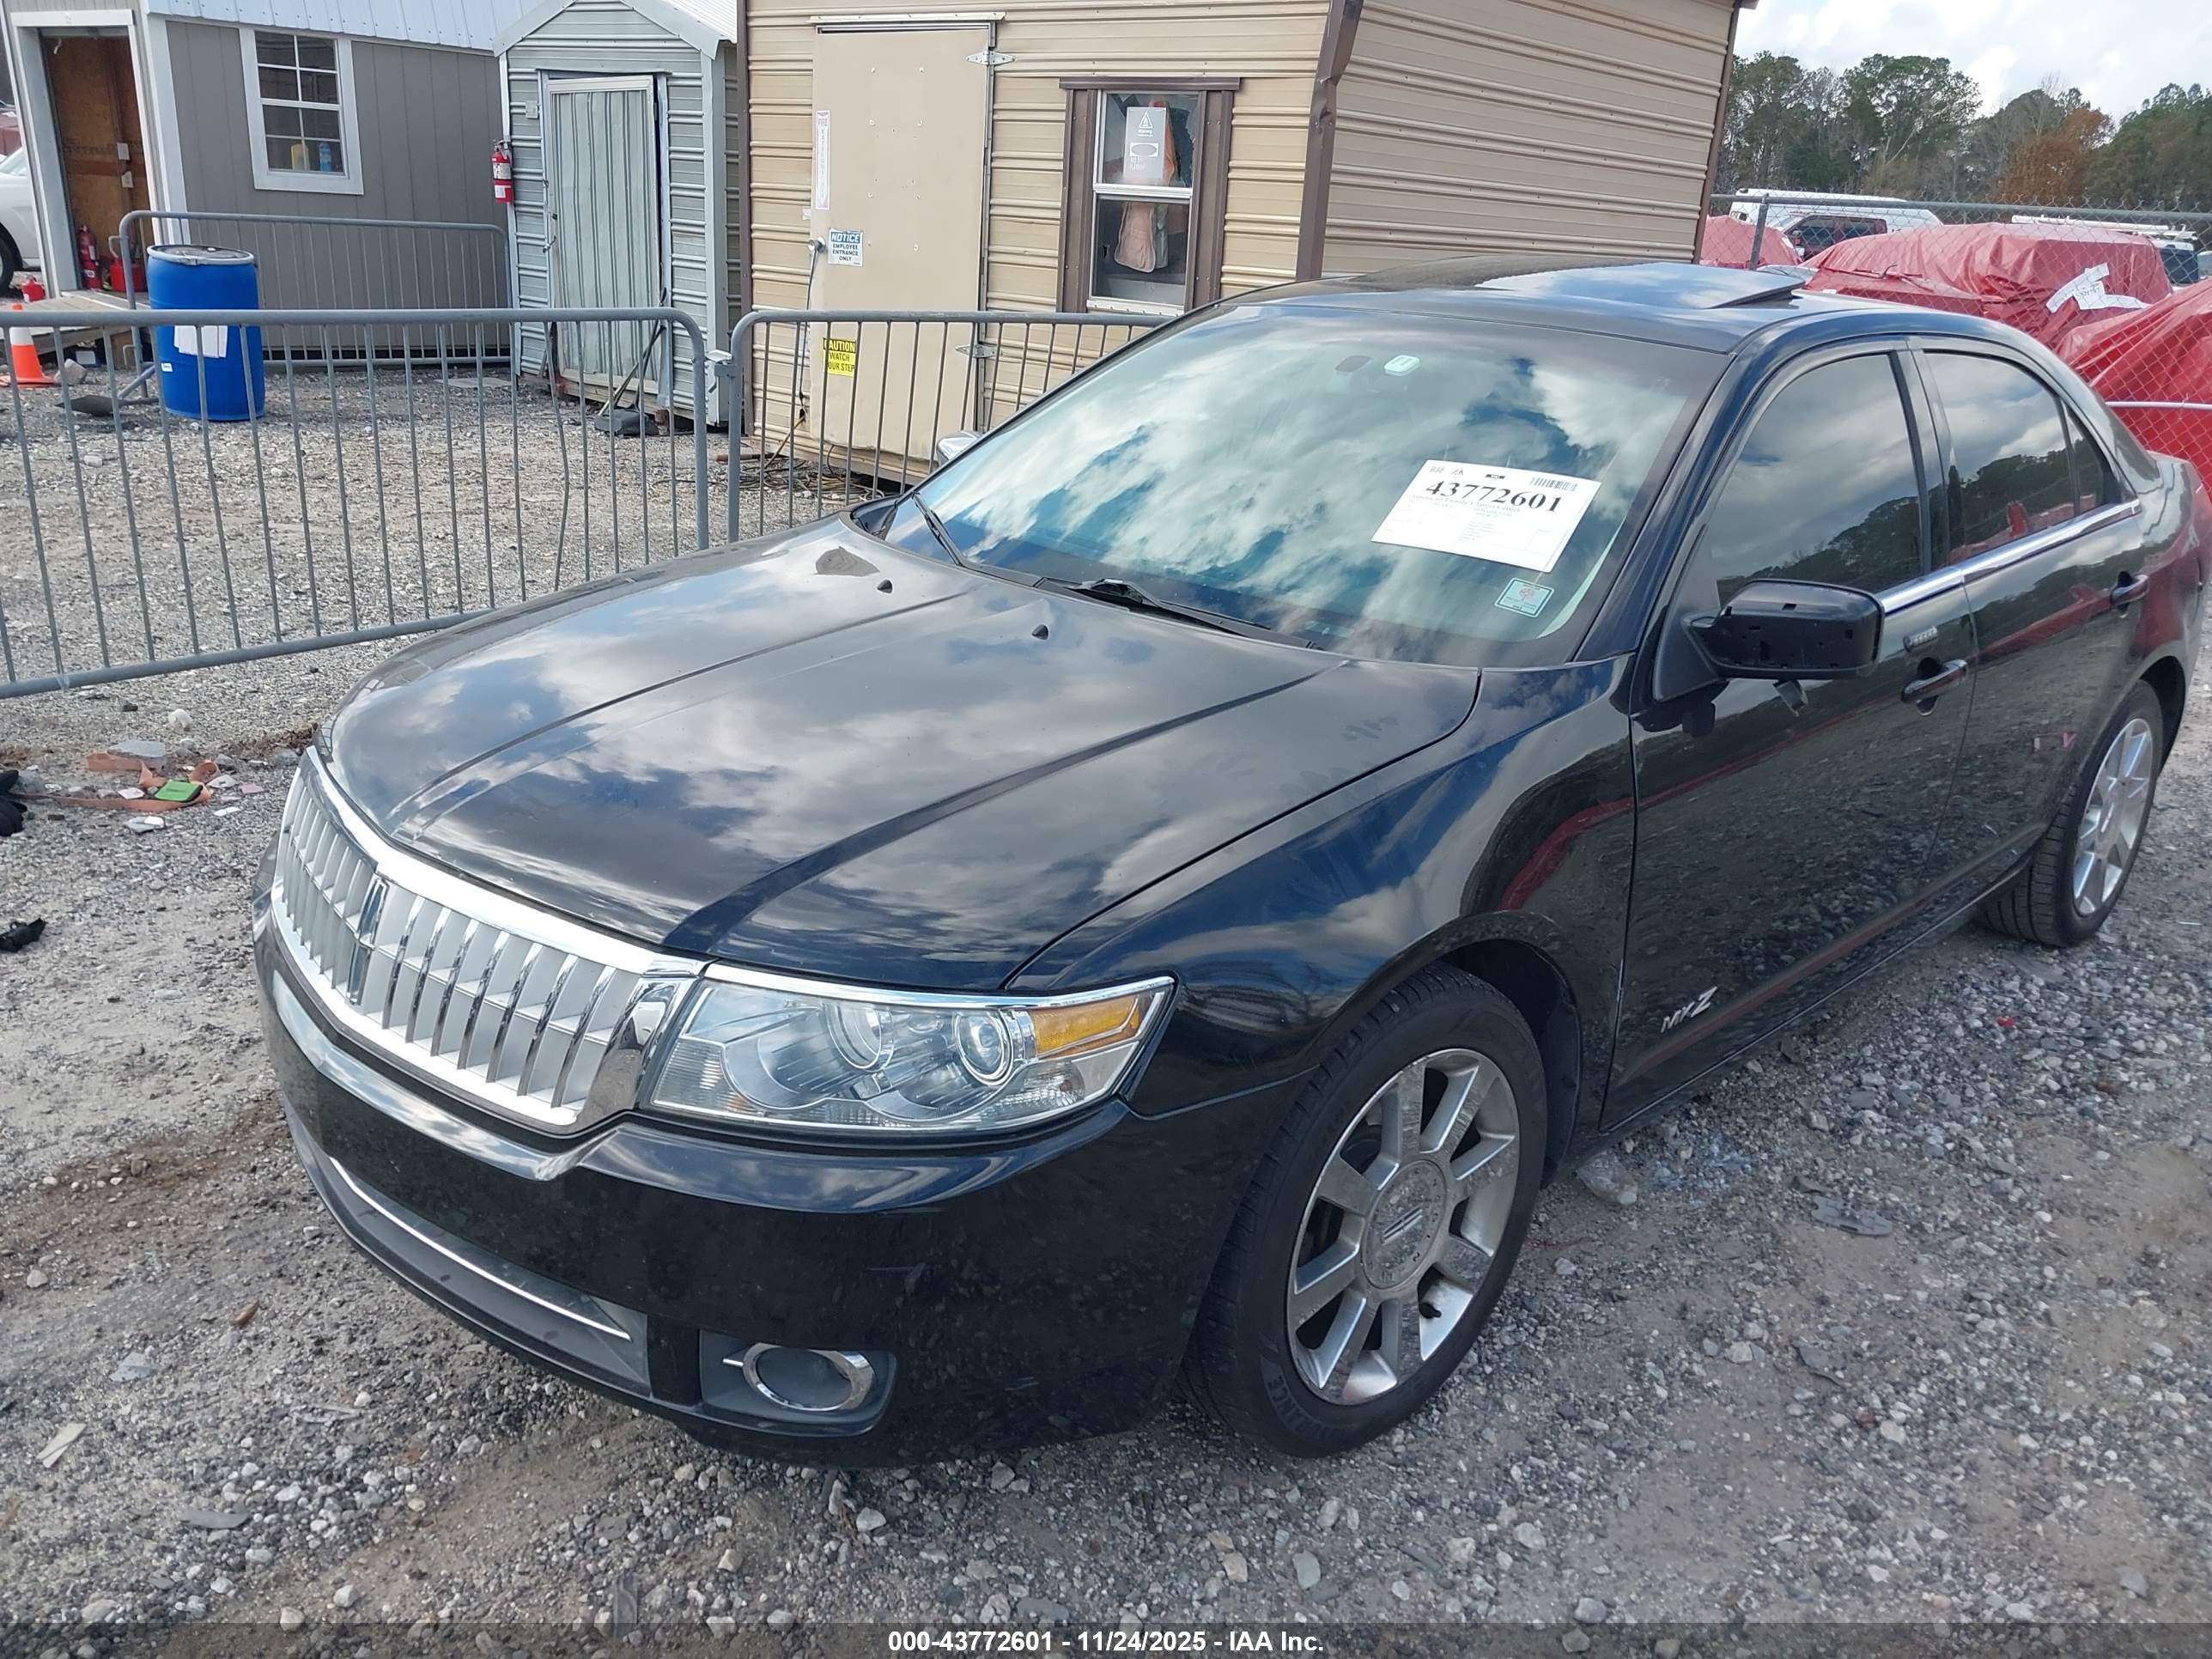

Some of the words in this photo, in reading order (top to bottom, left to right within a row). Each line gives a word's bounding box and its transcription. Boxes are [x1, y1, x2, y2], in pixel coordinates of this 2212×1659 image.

[831, 233, 860, 242] NOTICE
[830, 351, 850, 362] WATCH
[842, 363, 855, 372] STEP
[1425, 480, 1562, 512] 43772601
